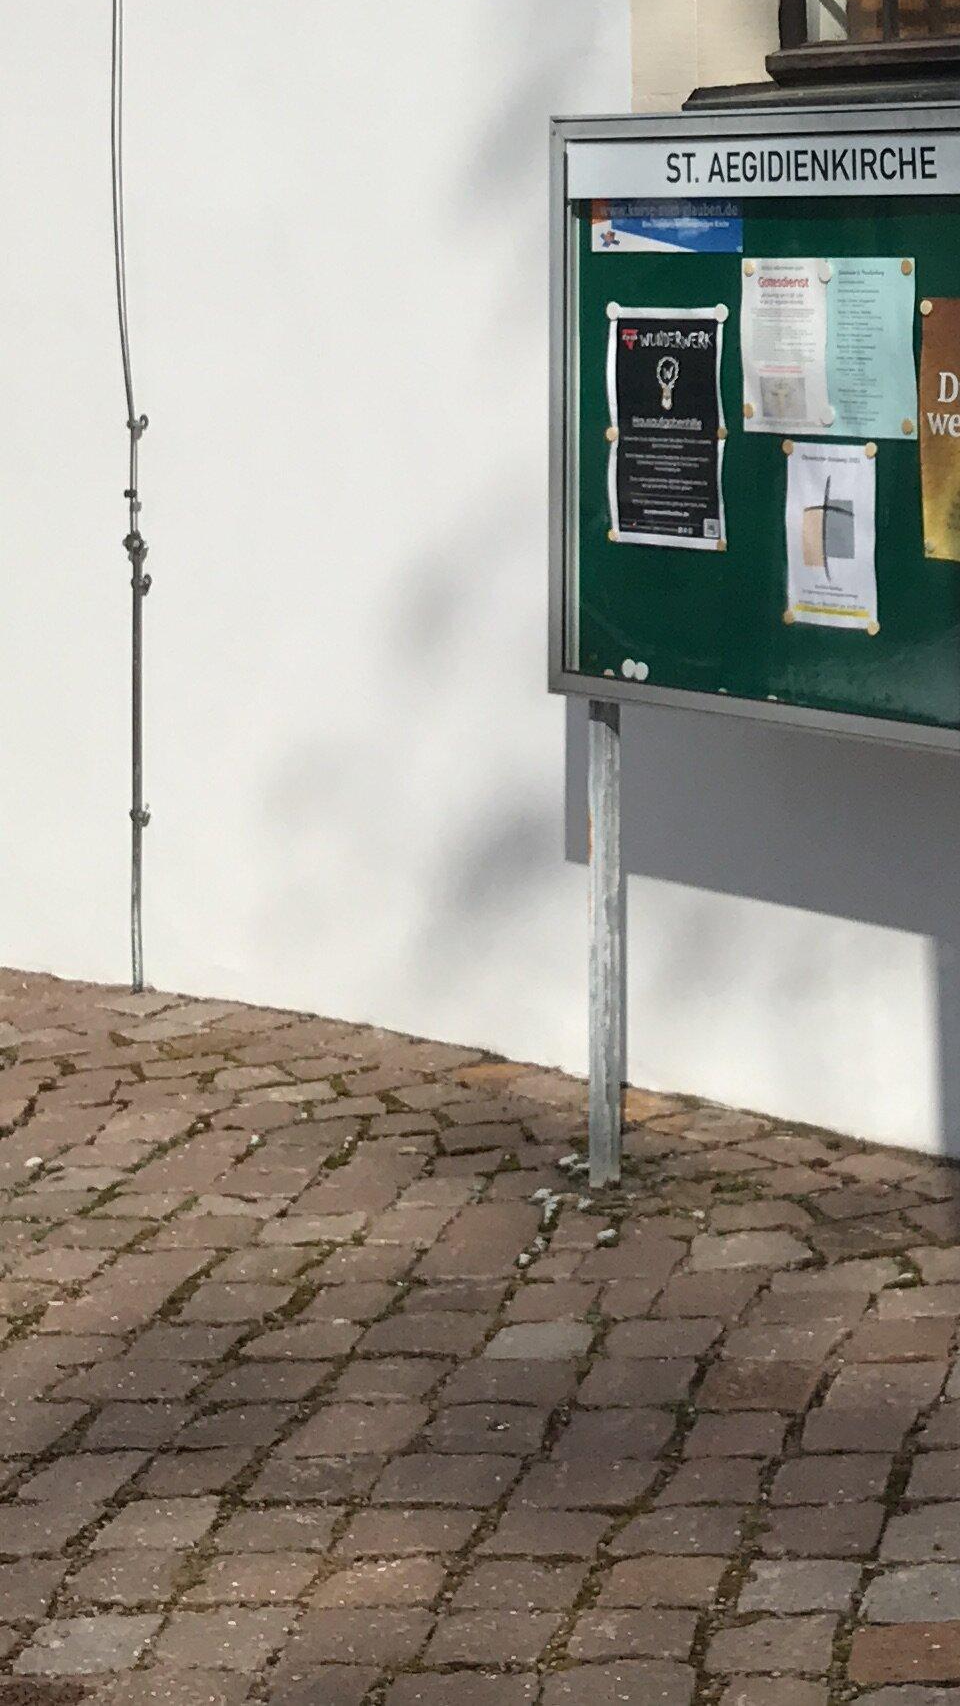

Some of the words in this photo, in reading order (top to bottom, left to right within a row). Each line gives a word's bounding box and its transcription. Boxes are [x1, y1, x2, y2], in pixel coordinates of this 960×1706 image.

[665, 152, 699, 184] ST.
[708, 146, 938, 183] AEGIDIENKIRCHE
[640, 330, 714, 350] WUNDERWERK
